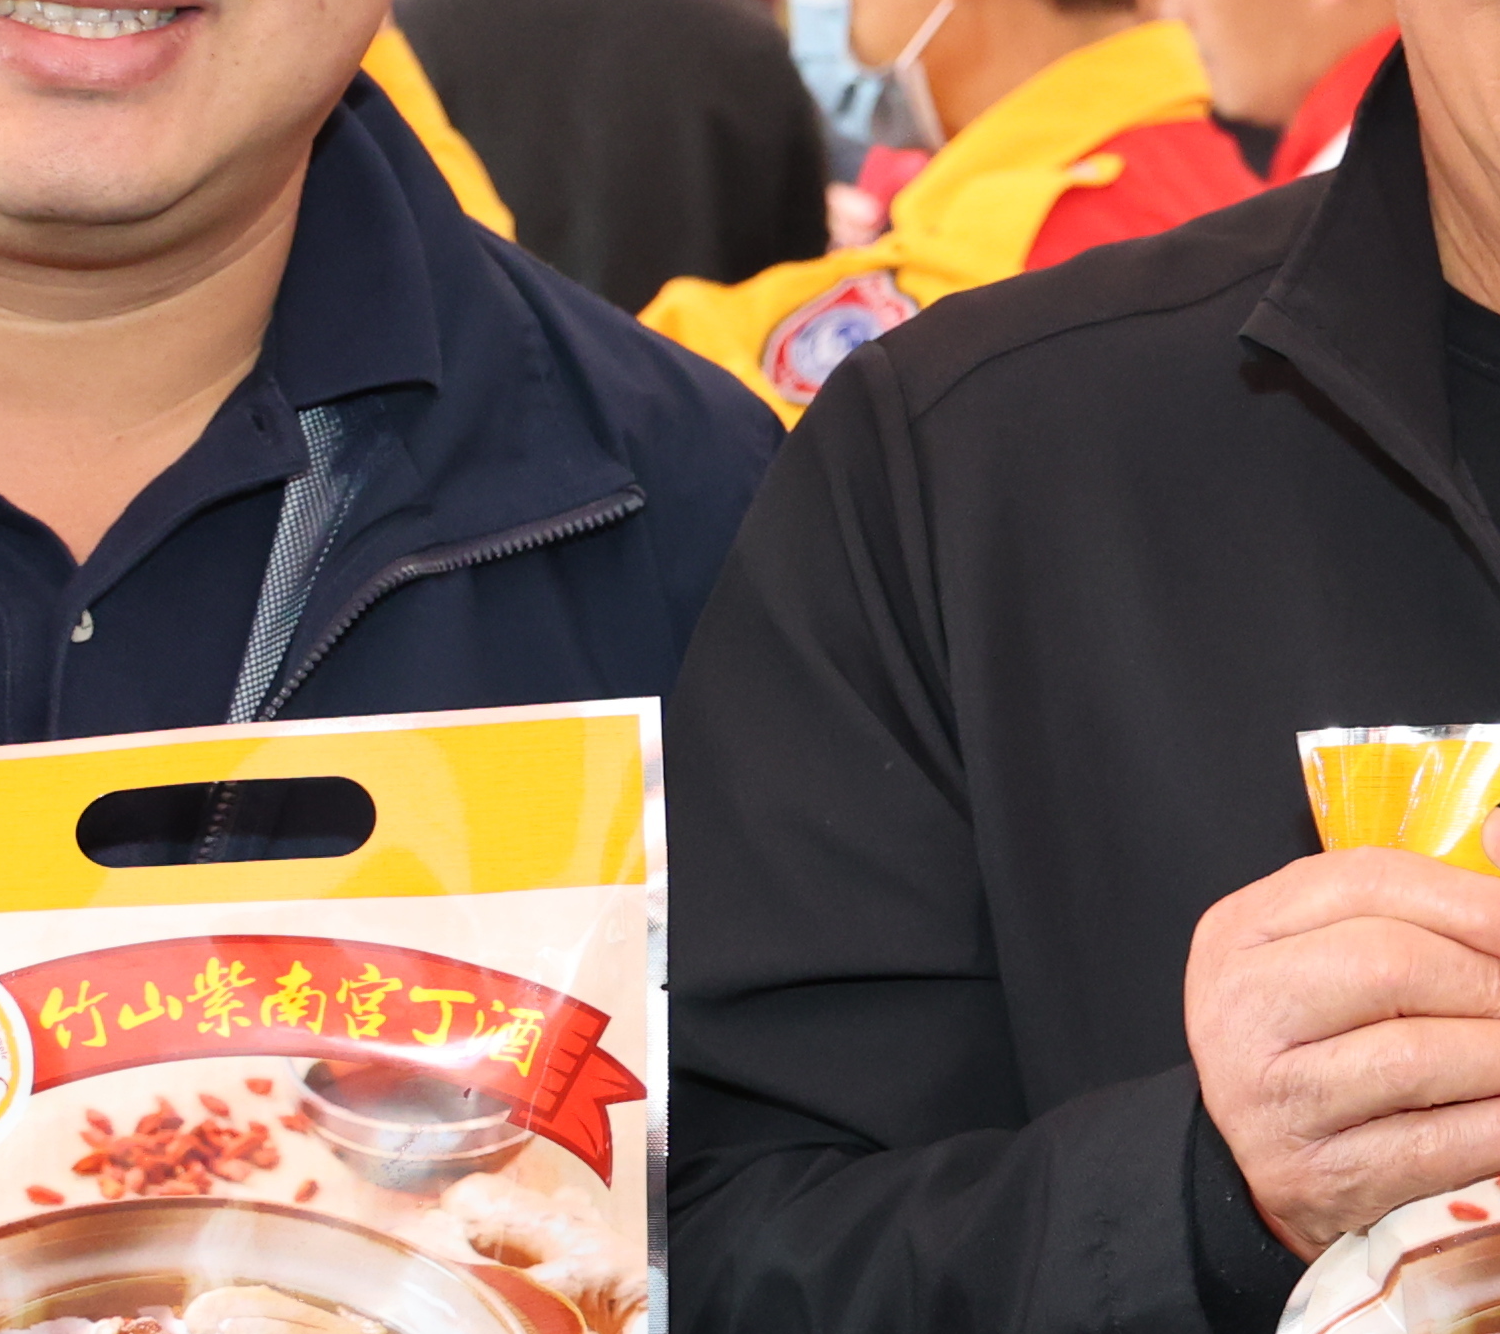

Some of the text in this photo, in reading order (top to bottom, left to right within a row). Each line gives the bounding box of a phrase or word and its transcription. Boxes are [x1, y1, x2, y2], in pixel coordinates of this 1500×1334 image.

[39, 956, 545, 1078] 竹山紫南宮丁酒
